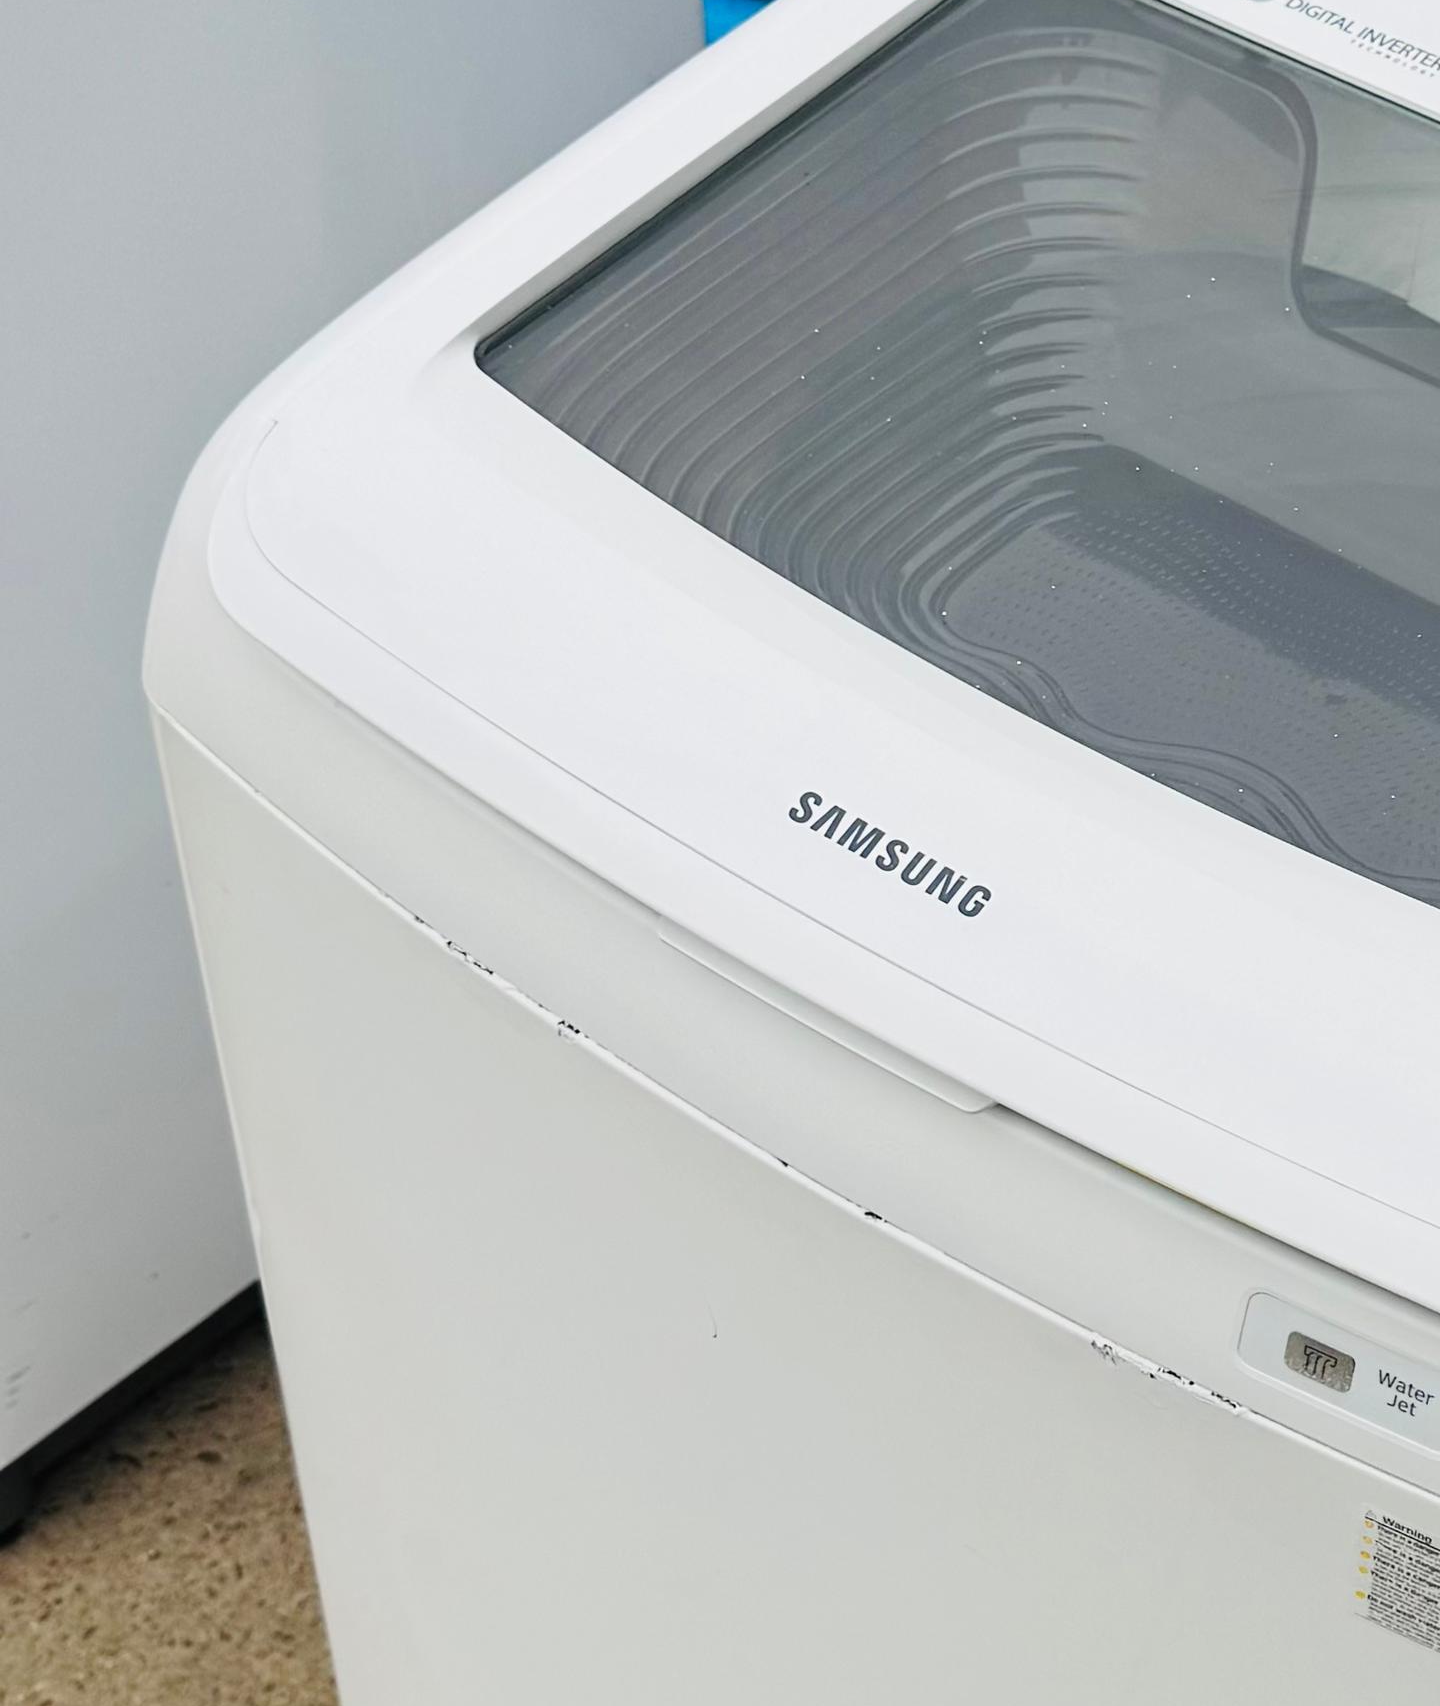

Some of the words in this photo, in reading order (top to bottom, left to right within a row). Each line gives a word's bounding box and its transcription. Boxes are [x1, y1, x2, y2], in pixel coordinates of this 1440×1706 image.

[788, 791, 992, 918] SAMSUNG
[1377, 1368, 1435, 1406] Water
[1387, 1394, 1418, 1418] Jet
[1382, 1515, 1433, 1545] Warning
